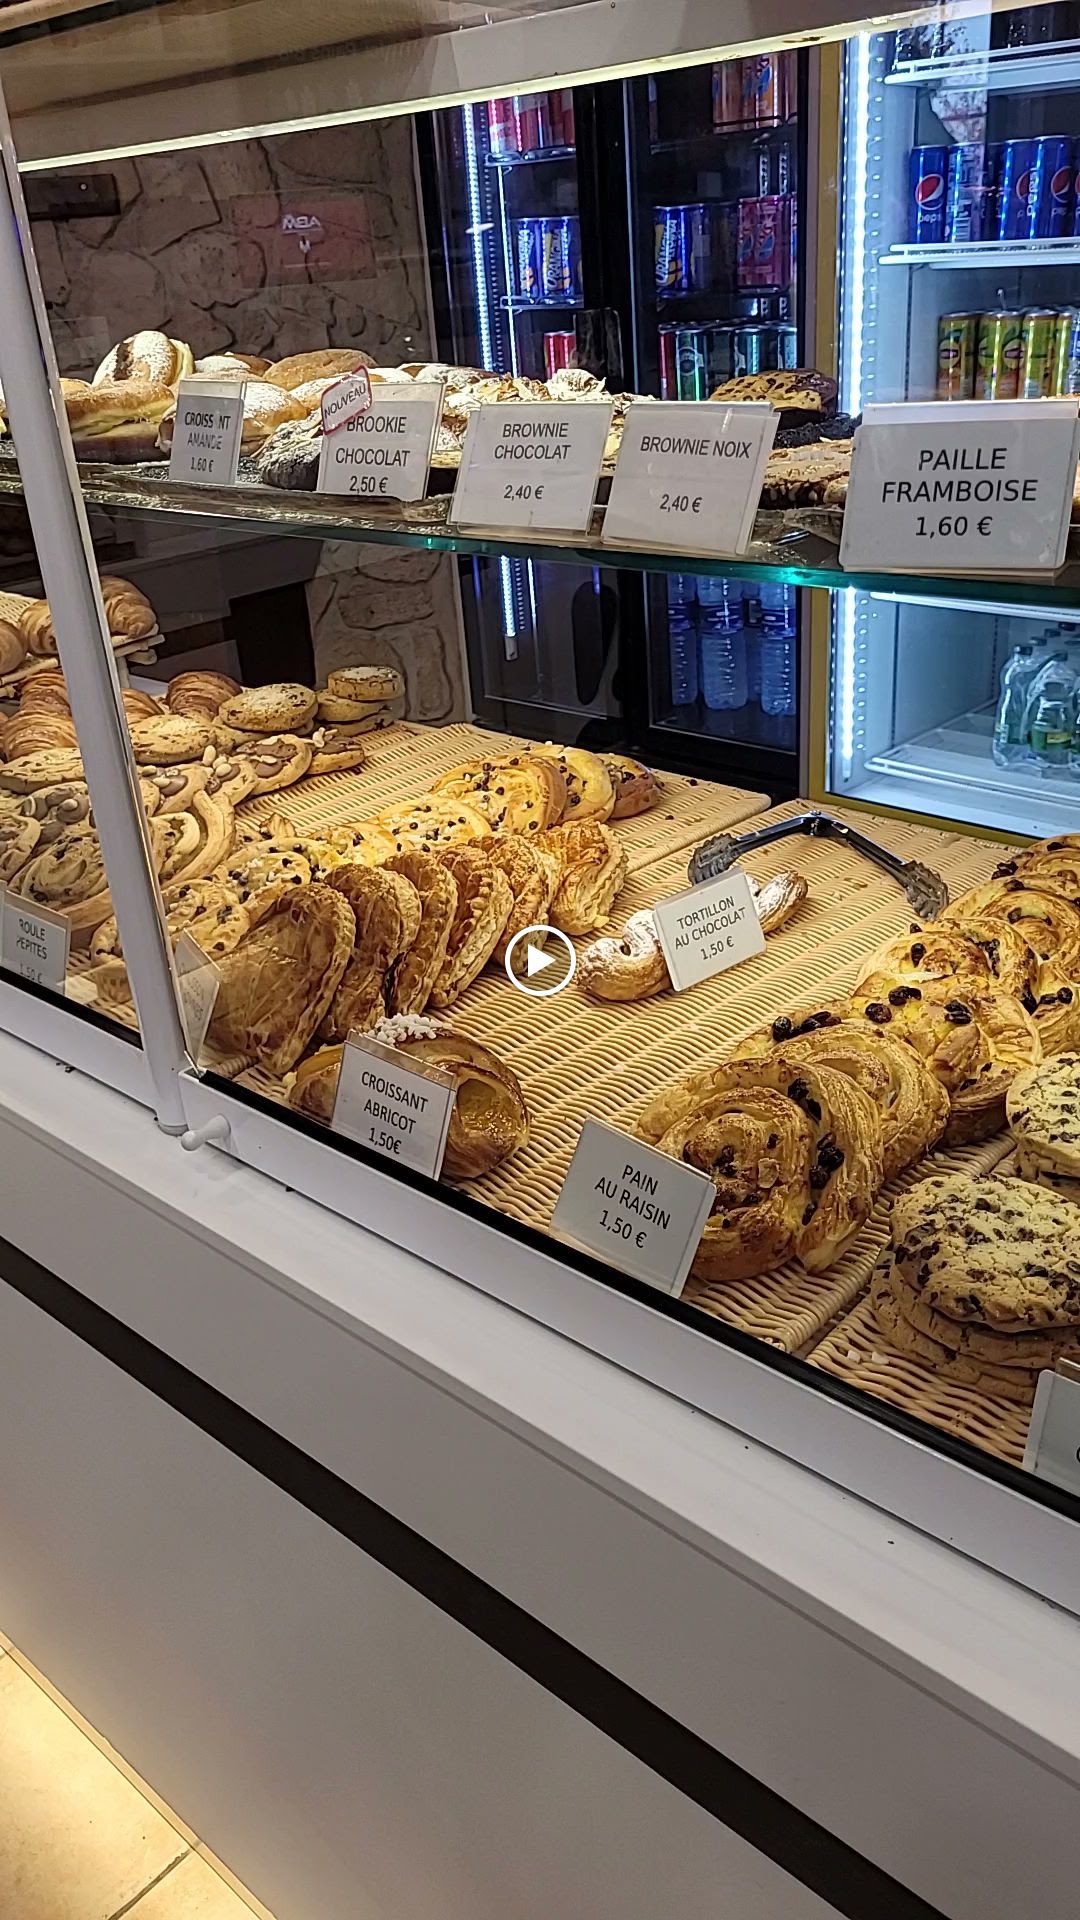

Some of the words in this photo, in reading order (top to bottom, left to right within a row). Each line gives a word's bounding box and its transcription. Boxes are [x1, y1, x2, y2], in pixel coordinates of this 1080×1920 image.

[324, 382, 366, 419] NOUVEAU
[184, 411, 231, 430] CROISSNT
[346, 416, 407, 433] BROOKIE
[502, 422, 569, 438] BROWNIE
[187, 432, 223, 450] AMANDE
[494, 444, 571, 460] CHOCOLAT
[640, 436, 710, 456] BROWNIE
[712, 440, 752, 459] NOIX
[335, 447, 410, 467] CHOCOLAT
[918, 448, 1007, 471] PAILLE
[349, 475, 376, 494] 2,50
[379, 477, 389, 494] €
[503, 484, 532, 501] 2,40
[534, 485, 544, 500] €
[881, 479, 1038, 503] FRAMBOISE
[659, 493, 690, 513] 2,40
[691, 497, 703, 514] €
[915, 516, 968, 539] 1,60
[976, 516, 993, 537] €
[676, 896, 735, 930] TORTILLON
[675, 933, 690, 950] AU
[692, 906, 746, 941] CHOCOLAT
[700, 941, 725, 961] 1,50
[726, 936, 735, 949] €
[361, 1071, 429, 1113] CROISSANT
[363, 1099, 417, 1134] ABRICOT
[368, 1127, 402, 1155] 1,50€
[622, 1164, 659, 1196] PAIN
[594, 1176, 618, 1199] AU
[619, 1188, 671, 1230] RAISIN
[599, 1209, 633, 1240] 1,50
[635, 1231, 648, 1249] €
